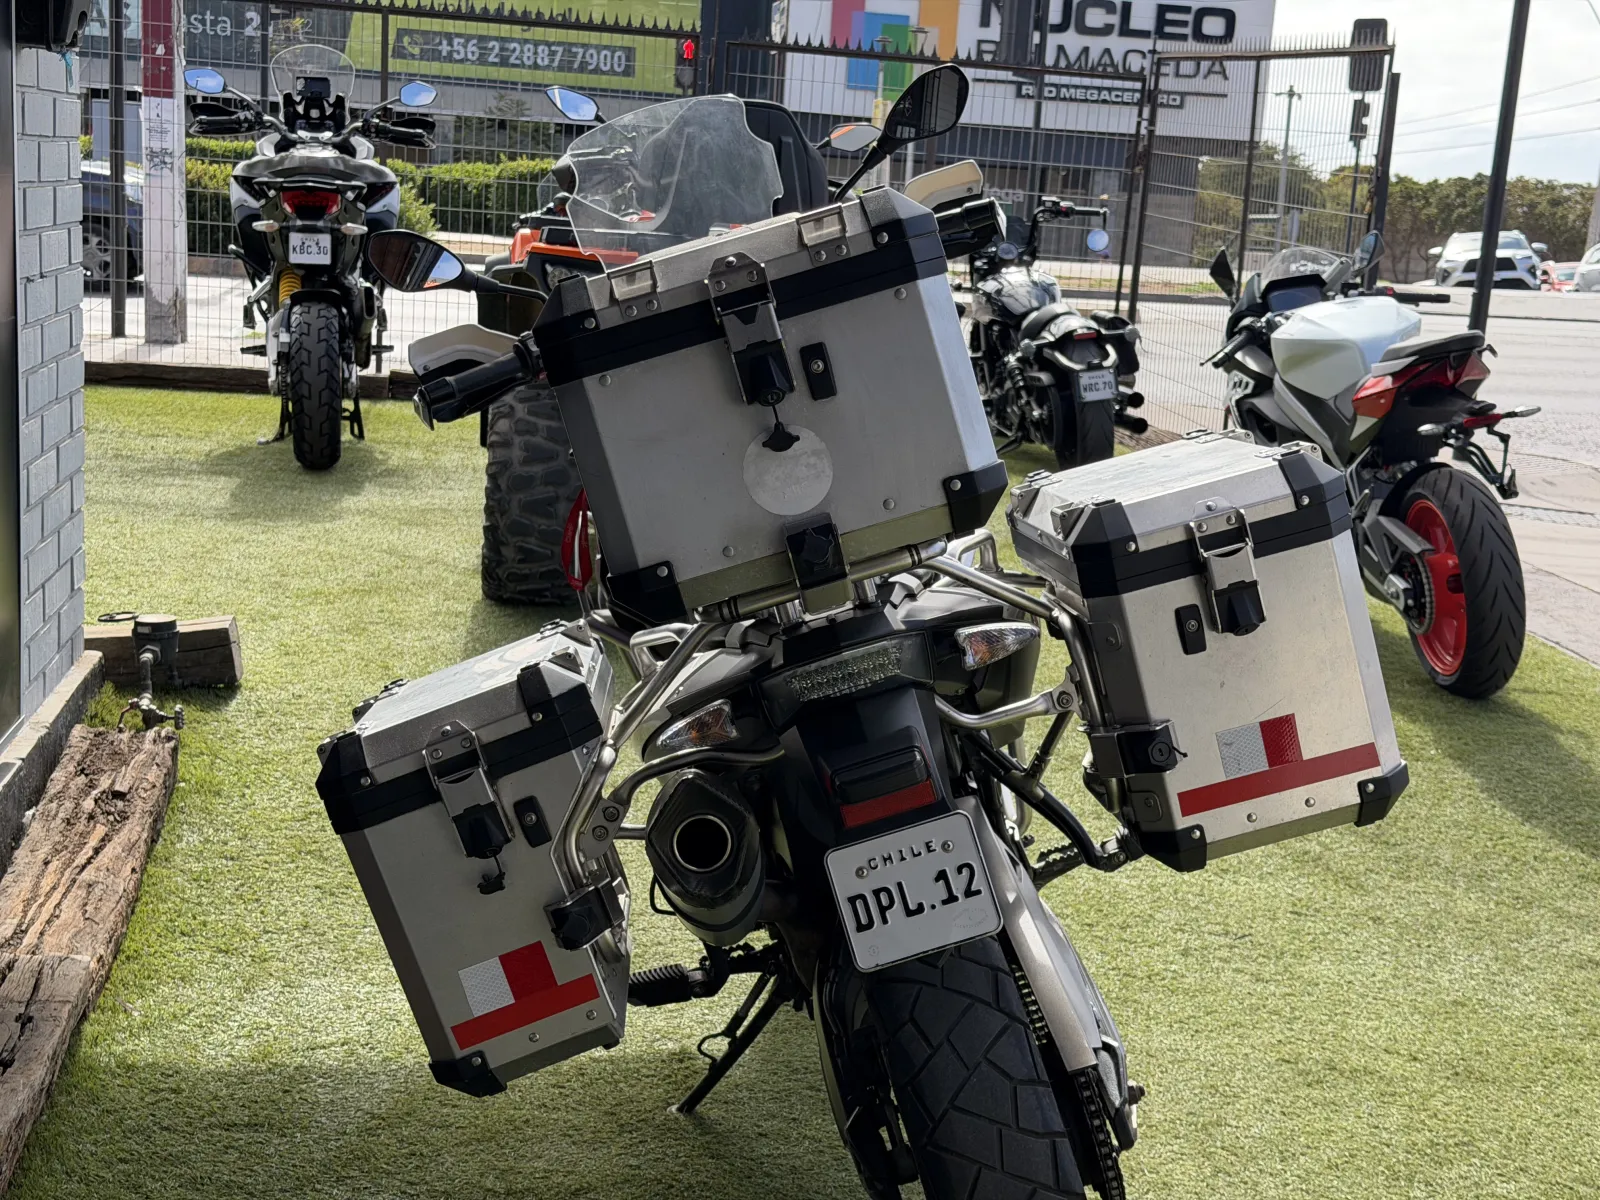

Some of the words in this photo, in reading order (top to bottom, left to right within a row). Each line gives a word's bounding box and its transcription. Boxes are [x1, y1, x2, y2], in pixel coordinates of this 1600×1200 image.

[438, 38, 479, 61] +56
[488, 41, 499, 63] 2
[508, 42, 562, 68] 2887
[573, 47, 626, 72] 7900
[1021, 85, 1056, 98] RD
[868, 840, 937, 870] CHILE
[847, 862, 982, 933] DPL.12
